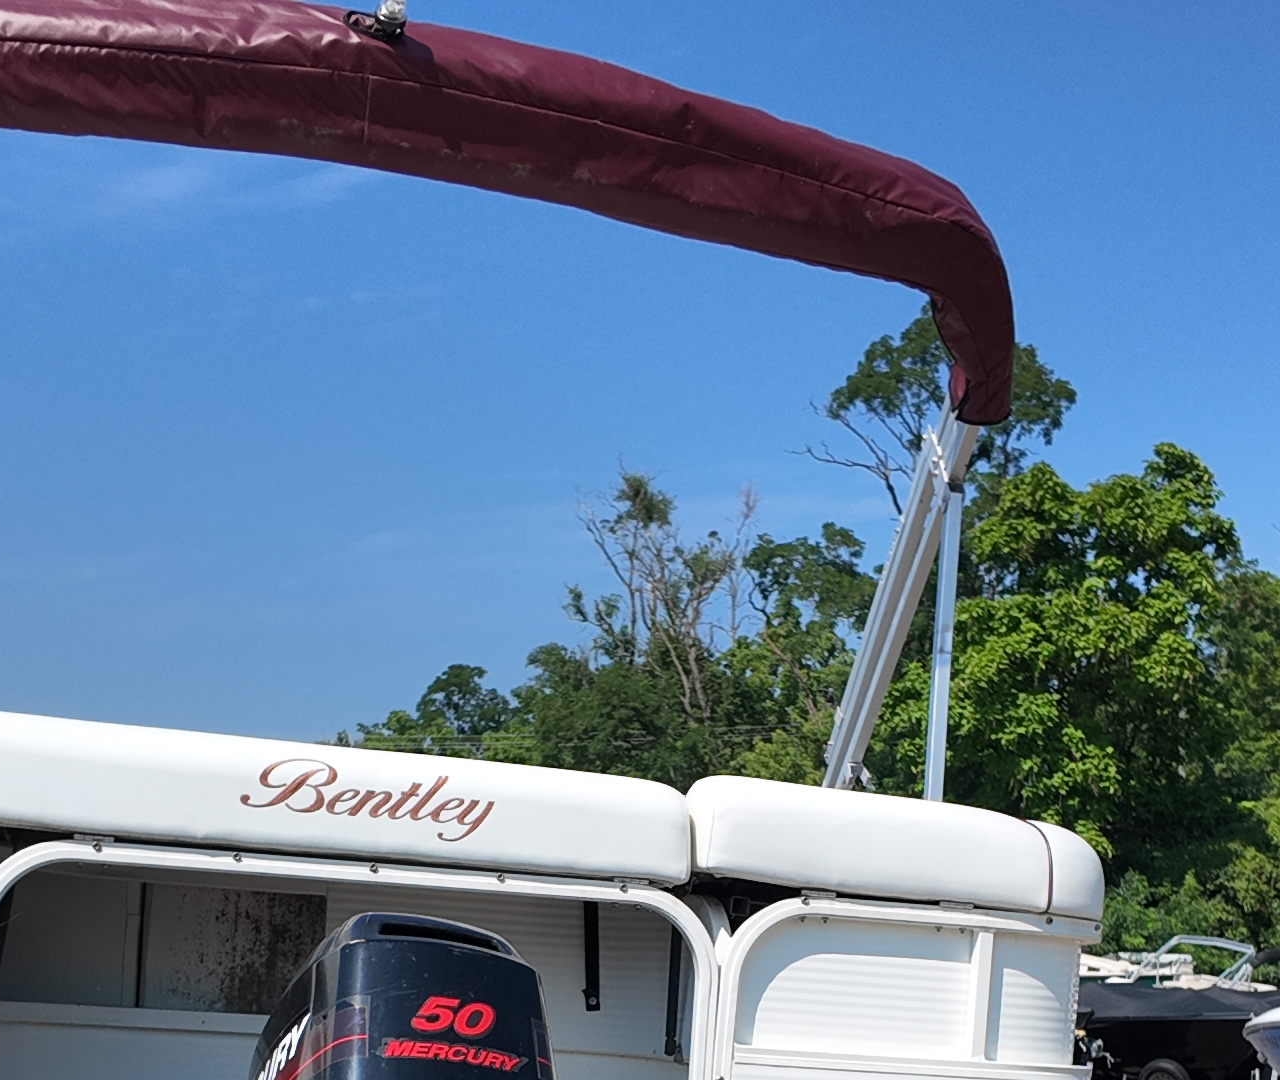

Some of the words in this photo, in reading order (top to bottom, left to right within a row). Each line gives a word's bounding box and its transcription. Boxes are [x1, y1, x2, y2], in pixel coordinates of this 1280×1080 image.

[240, 758, 496, 842] Bentley
[411, 995, 496, 1038] 50
[384, 1040, 520, 1072] MERCURY
